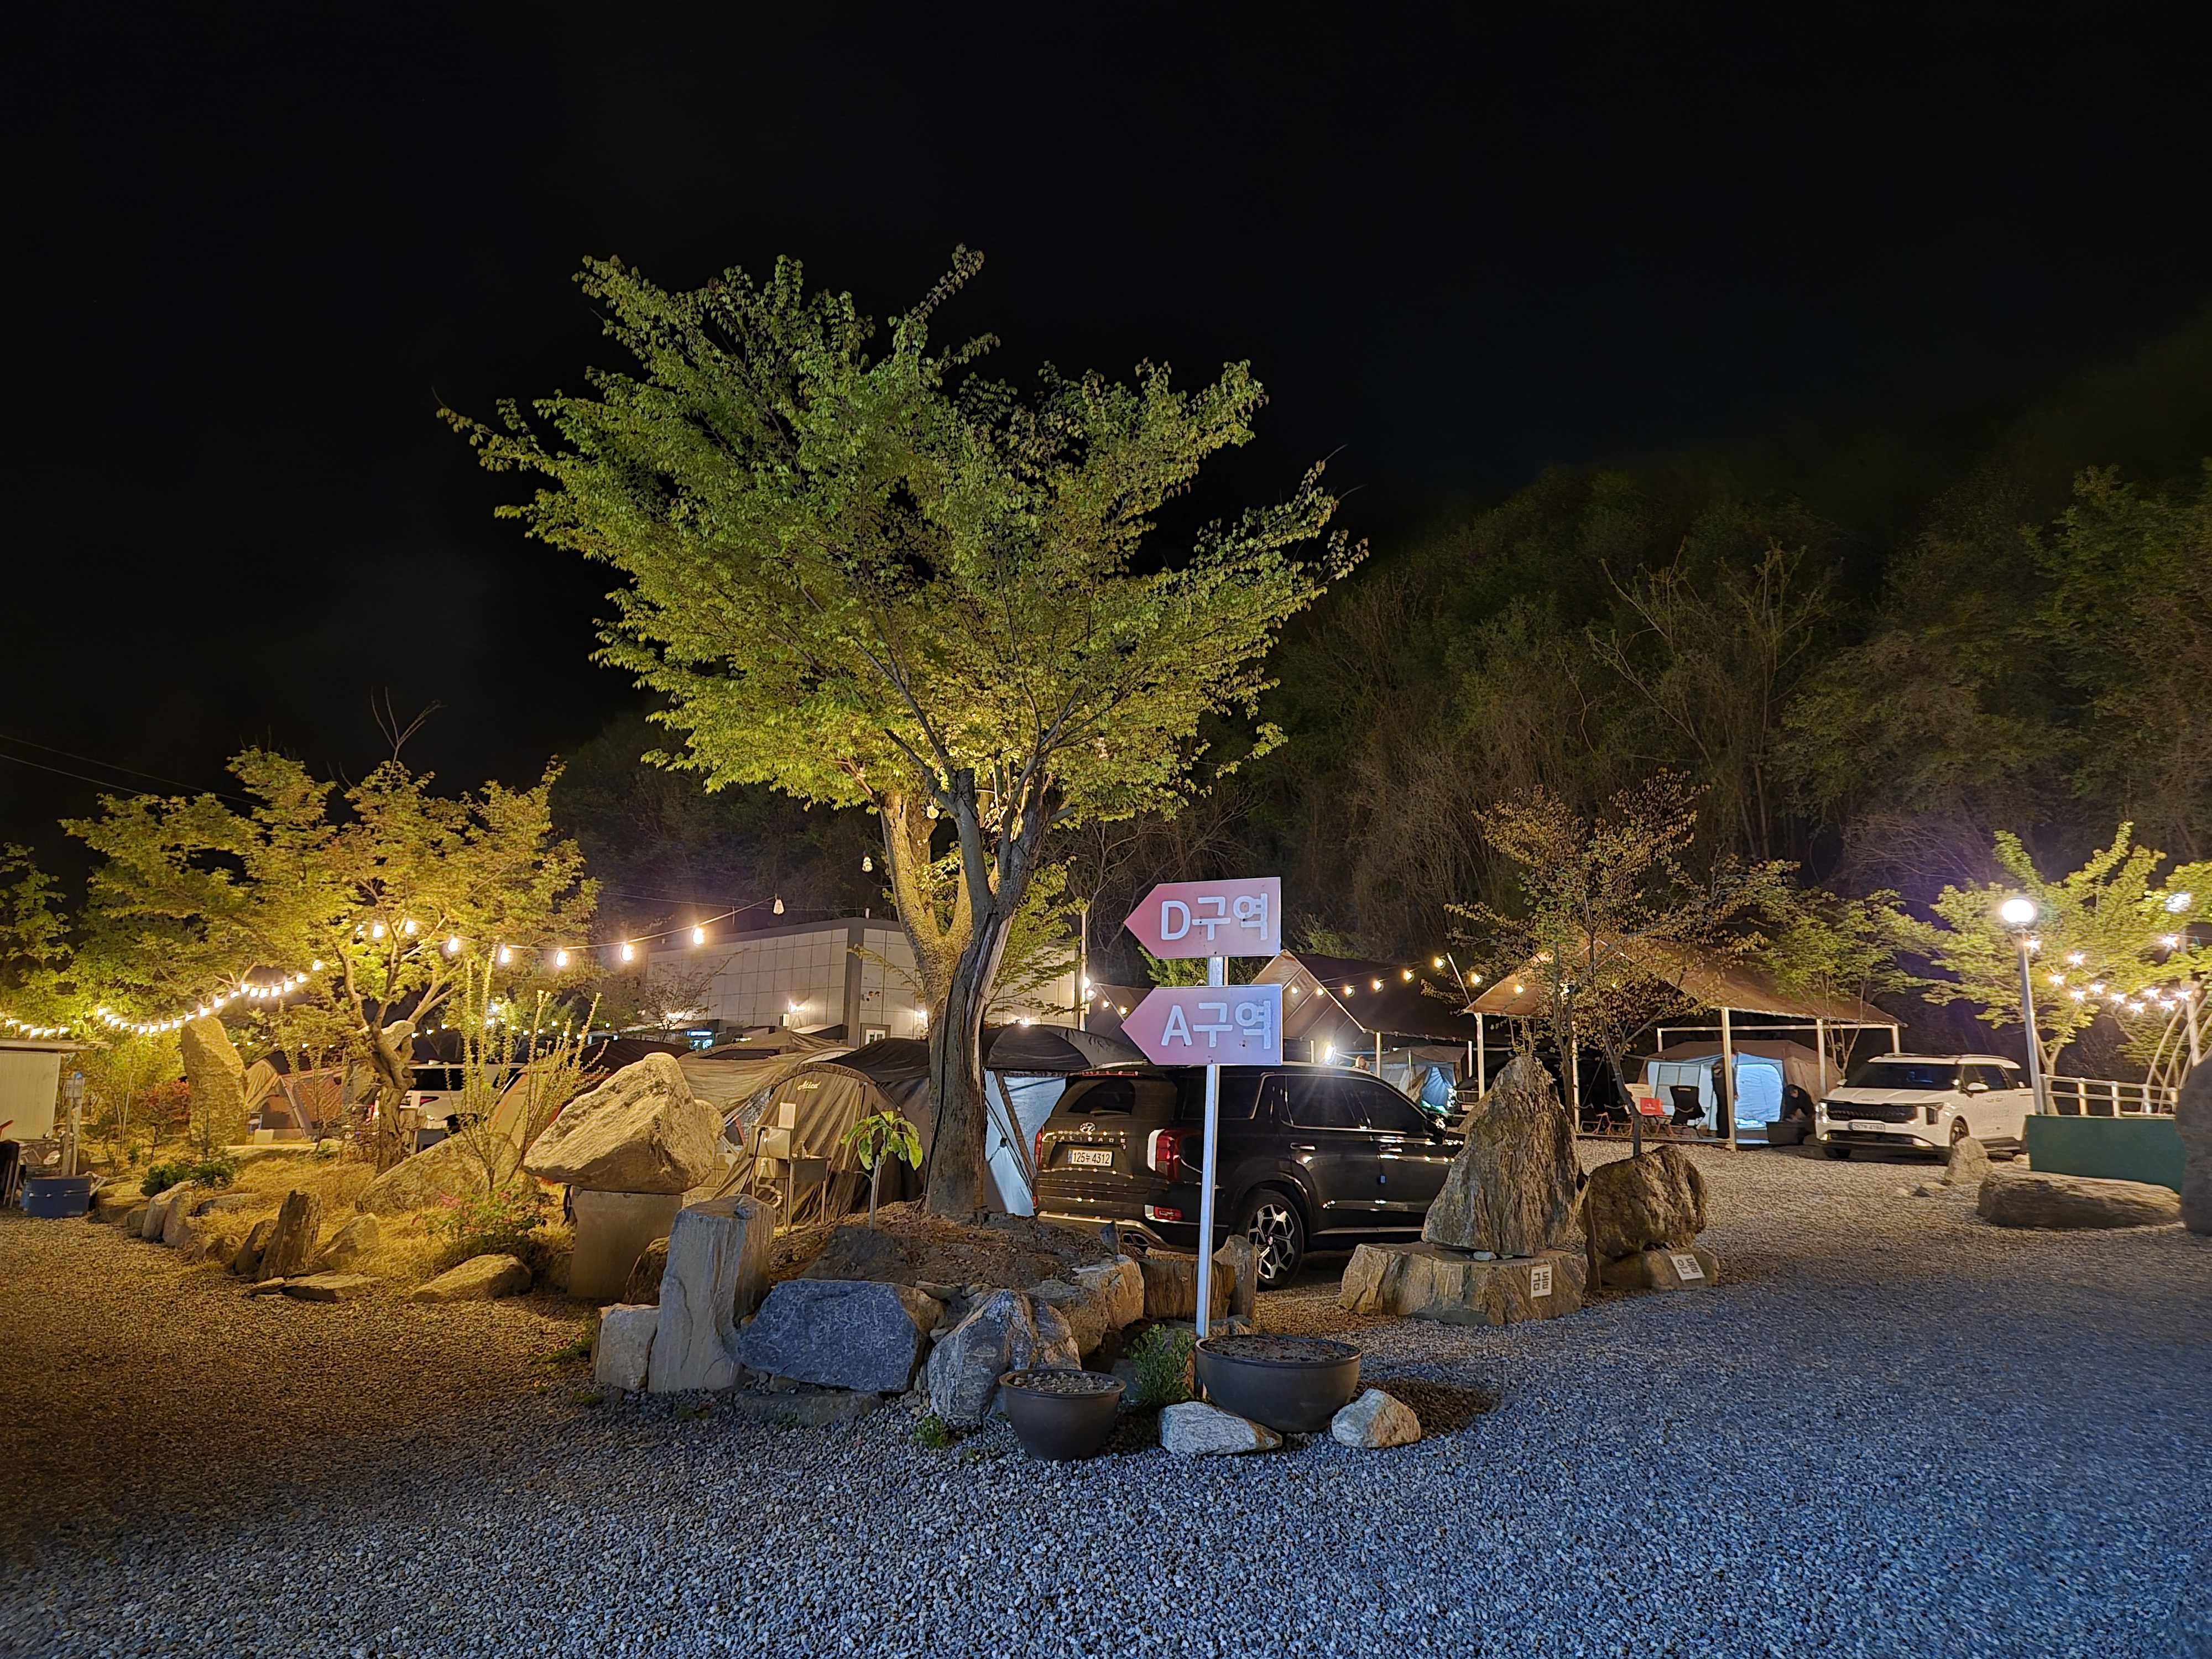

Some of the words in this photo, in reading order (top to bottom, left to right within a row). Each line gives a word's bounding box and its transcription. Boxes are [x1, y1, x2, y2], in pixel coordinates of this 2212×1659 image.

[1161, 893, 1268, 941] D구역
[1161, 1000, 1271, 1050] A구역
[1092, 1153, 1110, 1164] 4312
